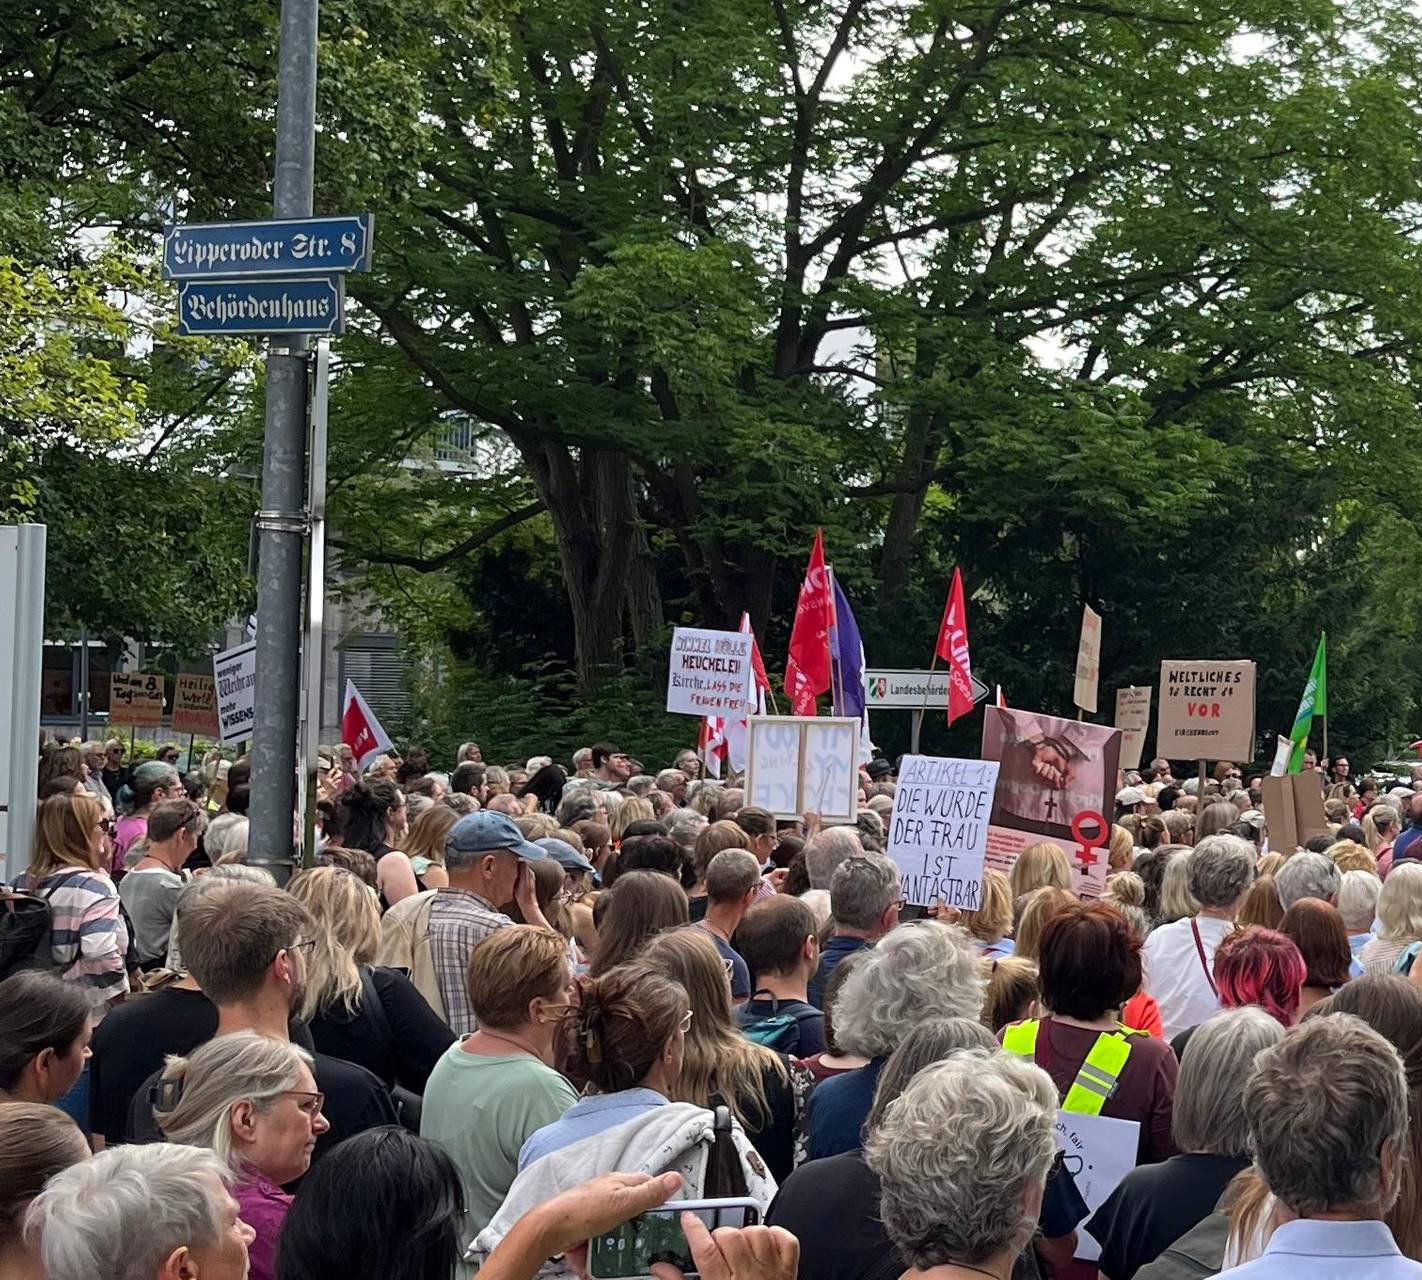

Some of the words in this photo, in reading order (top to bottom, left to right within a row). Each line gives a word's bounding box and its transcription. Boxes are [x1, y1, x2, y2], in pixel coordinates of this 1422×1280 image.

[174, 234, 284, 270] Lipperoder
[291, 233, 332, 259] Str.
[341, 232, 356, 256] 8
[187, 293, 330, 326] Behördenhaus
[217, 662, 243, 678] weniger
[1169, 670, 1242, 684] WELTLICHES
[218, 673, 256, 698] Weihrau
[1183, 687, 1217, 697] RECHT
[220, 702, 237, 715] mehr
[221, 706, 255, 729] WISSENS
[1187, 702, 1221, 718] VOR
[904, 761, 967, 785] ARTIKEL
[976, 767, 993, 786] 1:
[897, 788, 922, 813] DIE
[894, 819, 924, 846] DER
[930, 820, 979, 850] FRAU
[923, 853, 959, 878] IST
[900, 874, 979, 909] ANTASTBAR
[1068, 1132, 1084, 1150] fair
